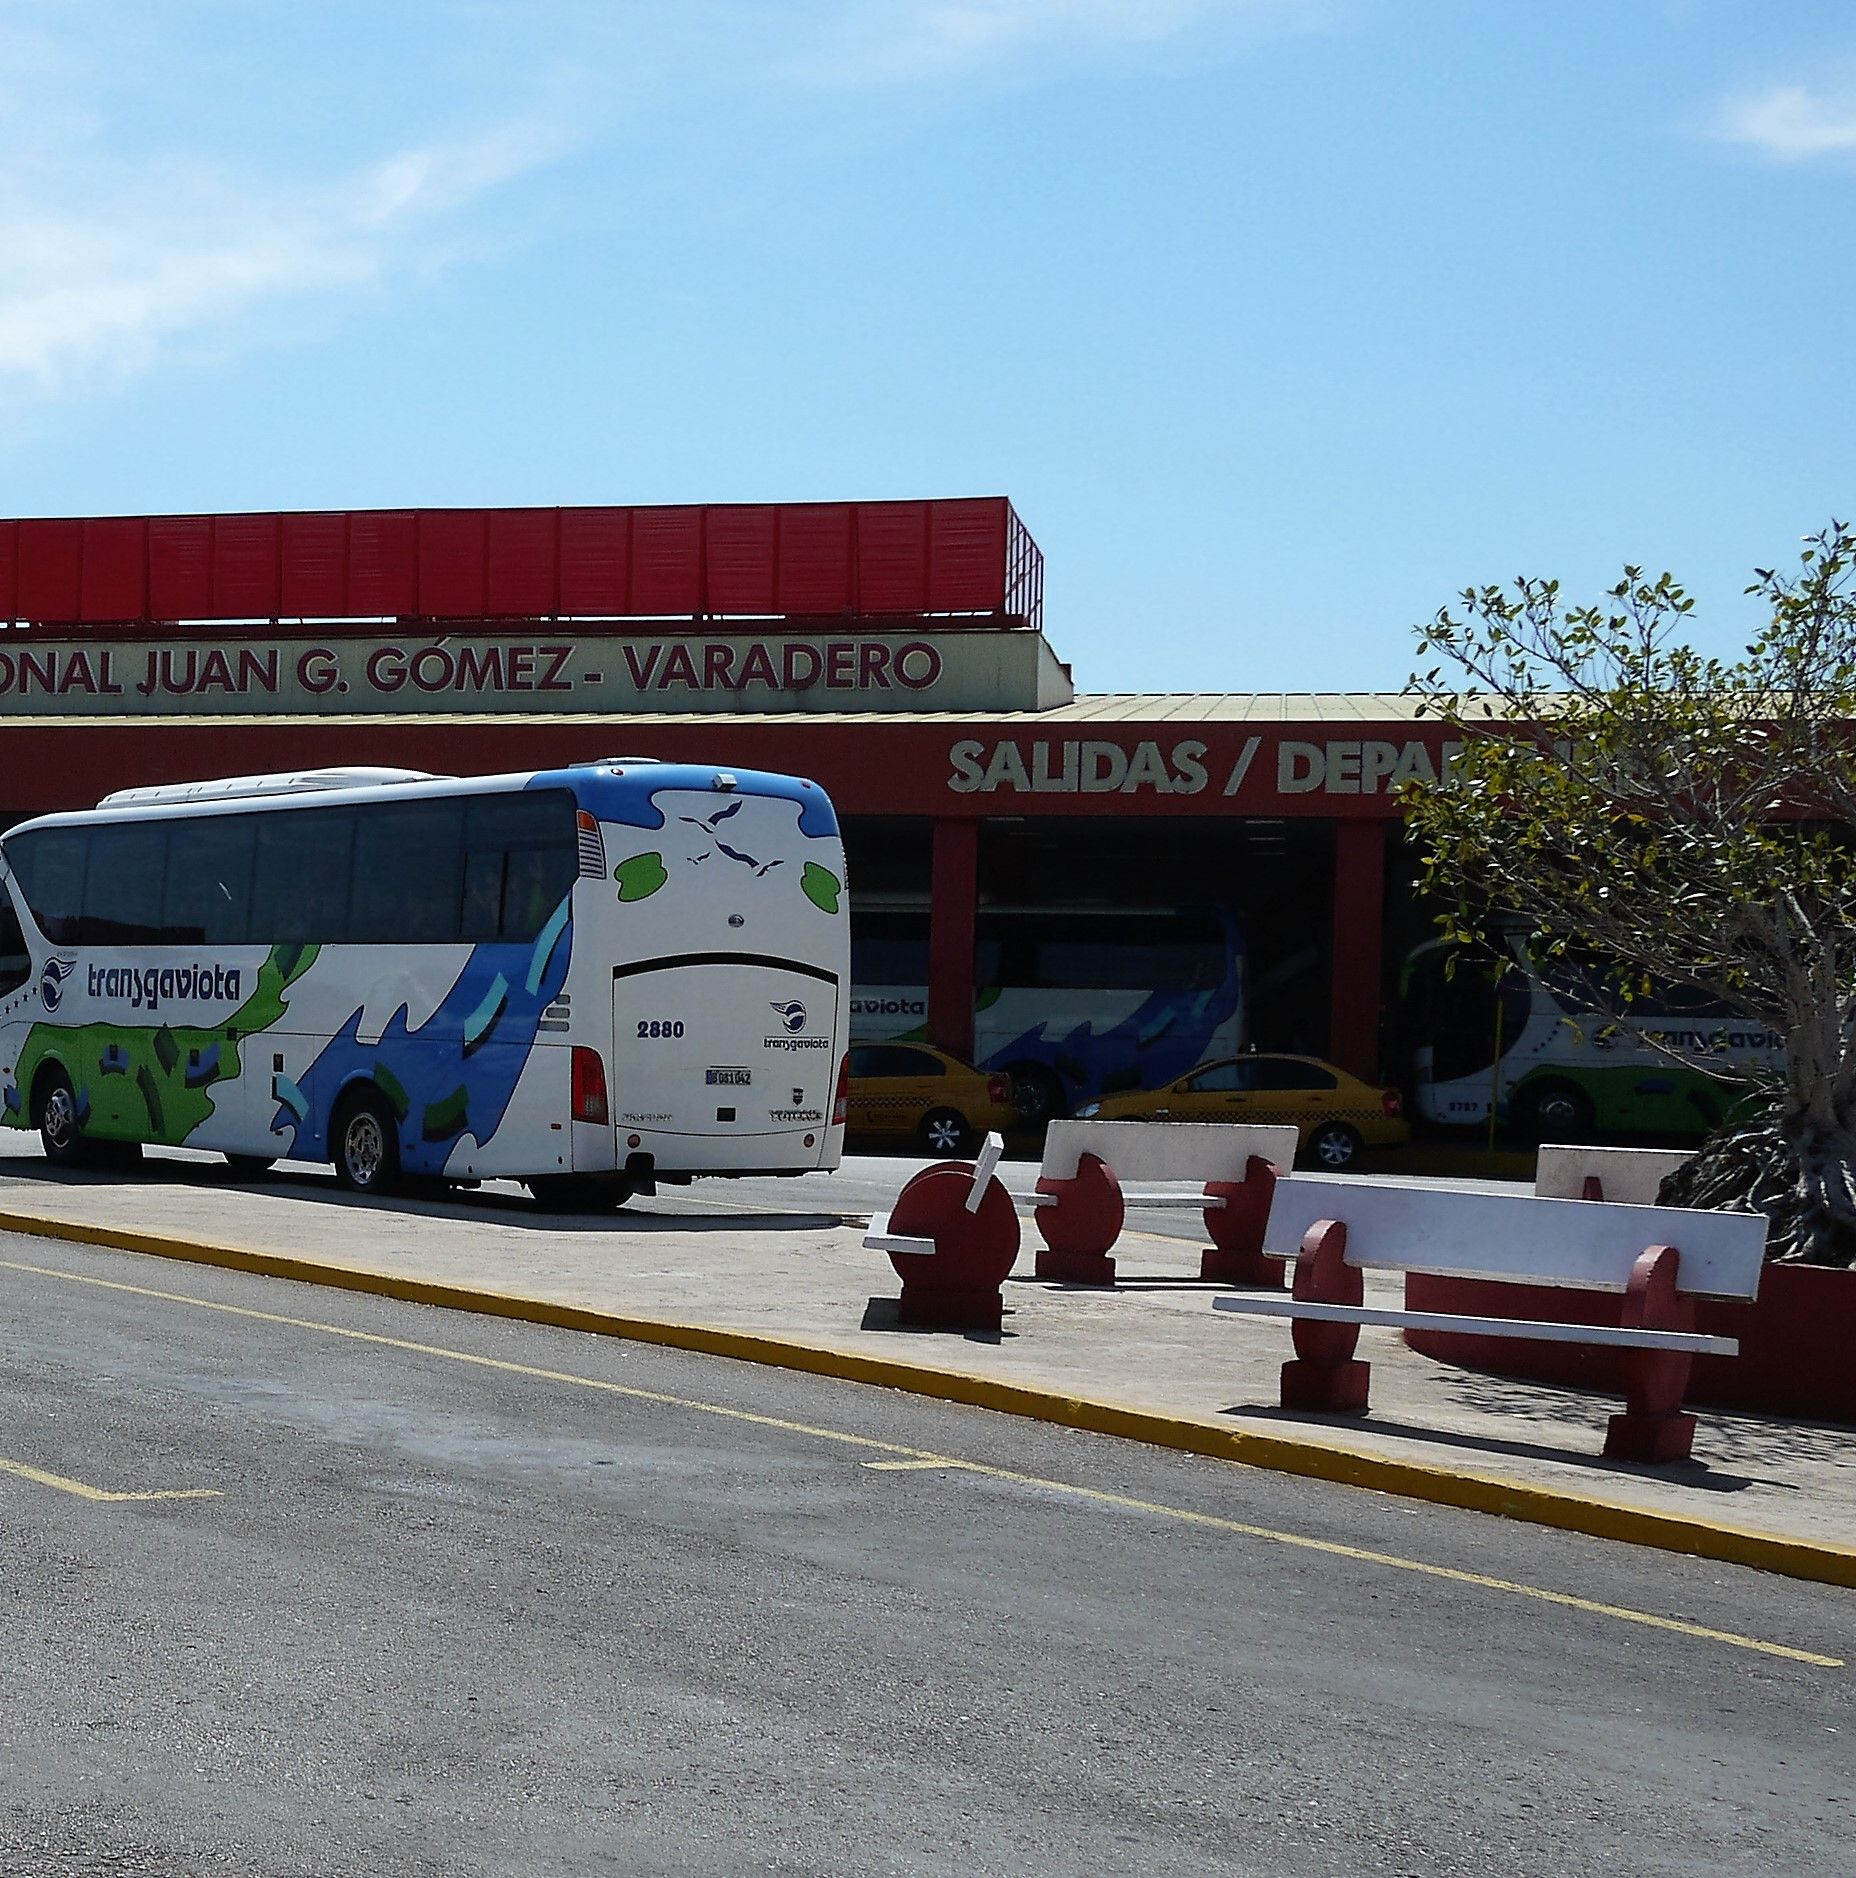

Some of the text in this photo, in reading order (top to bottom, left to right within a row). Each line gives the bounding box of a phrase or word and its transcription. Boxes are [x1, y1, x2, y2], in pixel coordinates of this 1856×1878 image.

[136, 649, 280, 697] JUAN
[296, 648, 350, 693] G.
[365, 636, 575, 692] GÓMEZ
[621, 641, 943, 691] VARADERO
[947, 739, 1208, 793] SALIDAS
[1222, 736, 1262, 796] /
[88, 963, 241, 1010] transgaviota
[850, 999, 924, 1015] aviota
[637, 1020, 685, 1038] 2880
[763, 1038, 829, 1052] transgaviota
